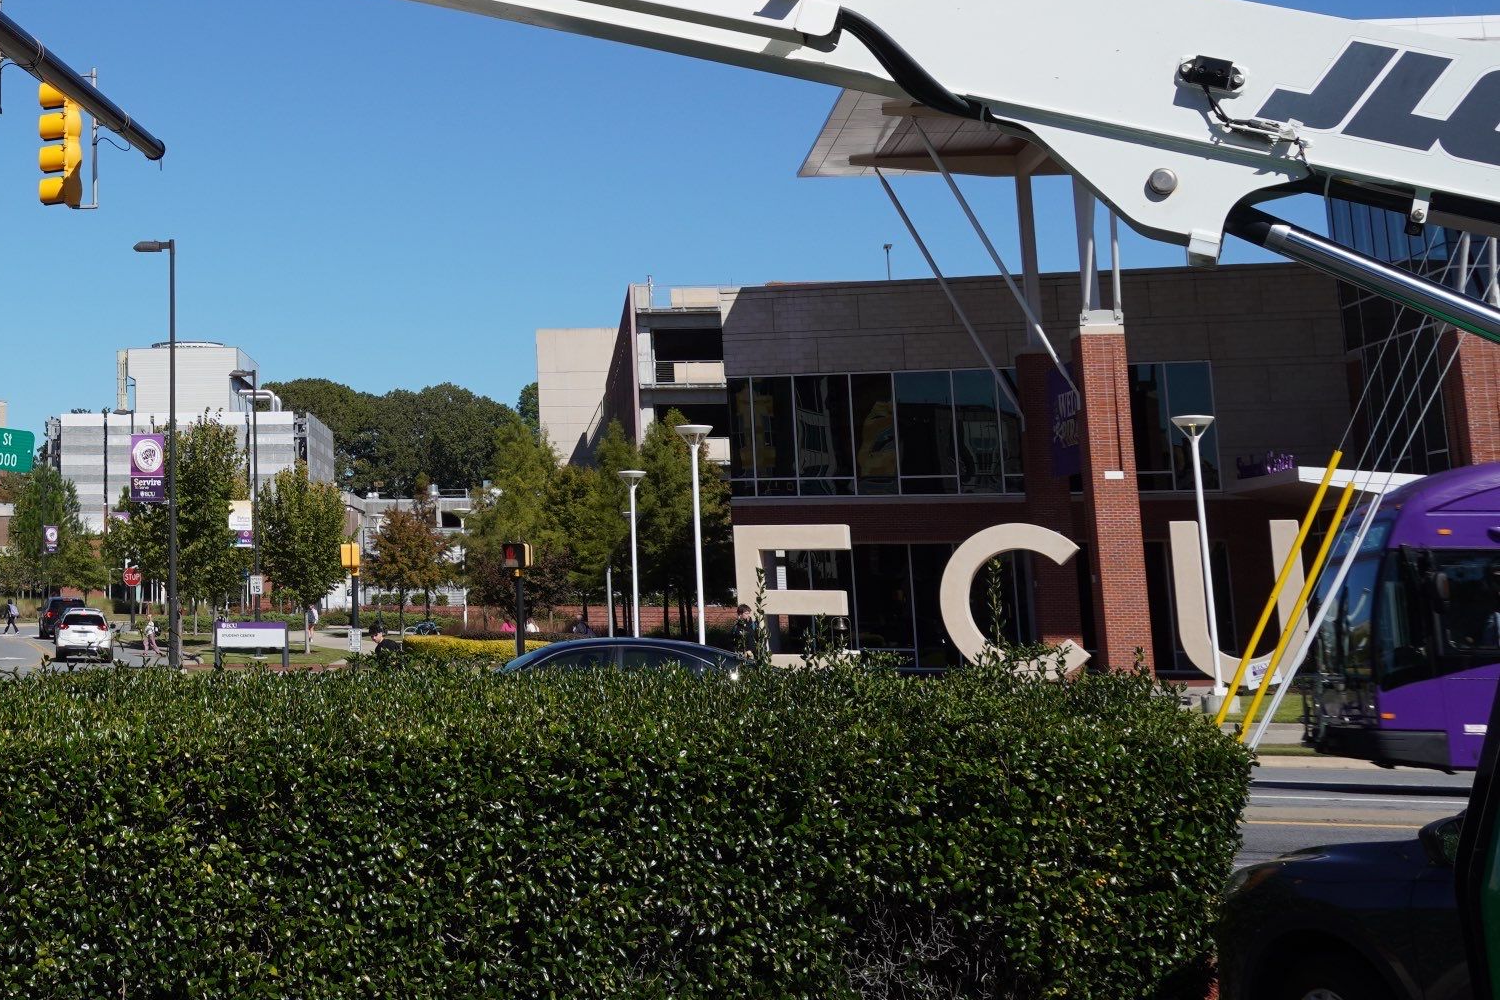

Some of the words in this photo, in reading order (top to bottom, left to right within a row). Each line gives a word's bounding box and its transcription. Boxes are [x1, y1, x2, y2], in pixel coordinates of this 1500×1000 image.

[2, 432, 13, 447] St
[133, 477, 162, 487] Servire
[124, 573, 140, 581] STOP
[252, 585, 261, 593] 15
[733, 520, 1310, 689] ECU
